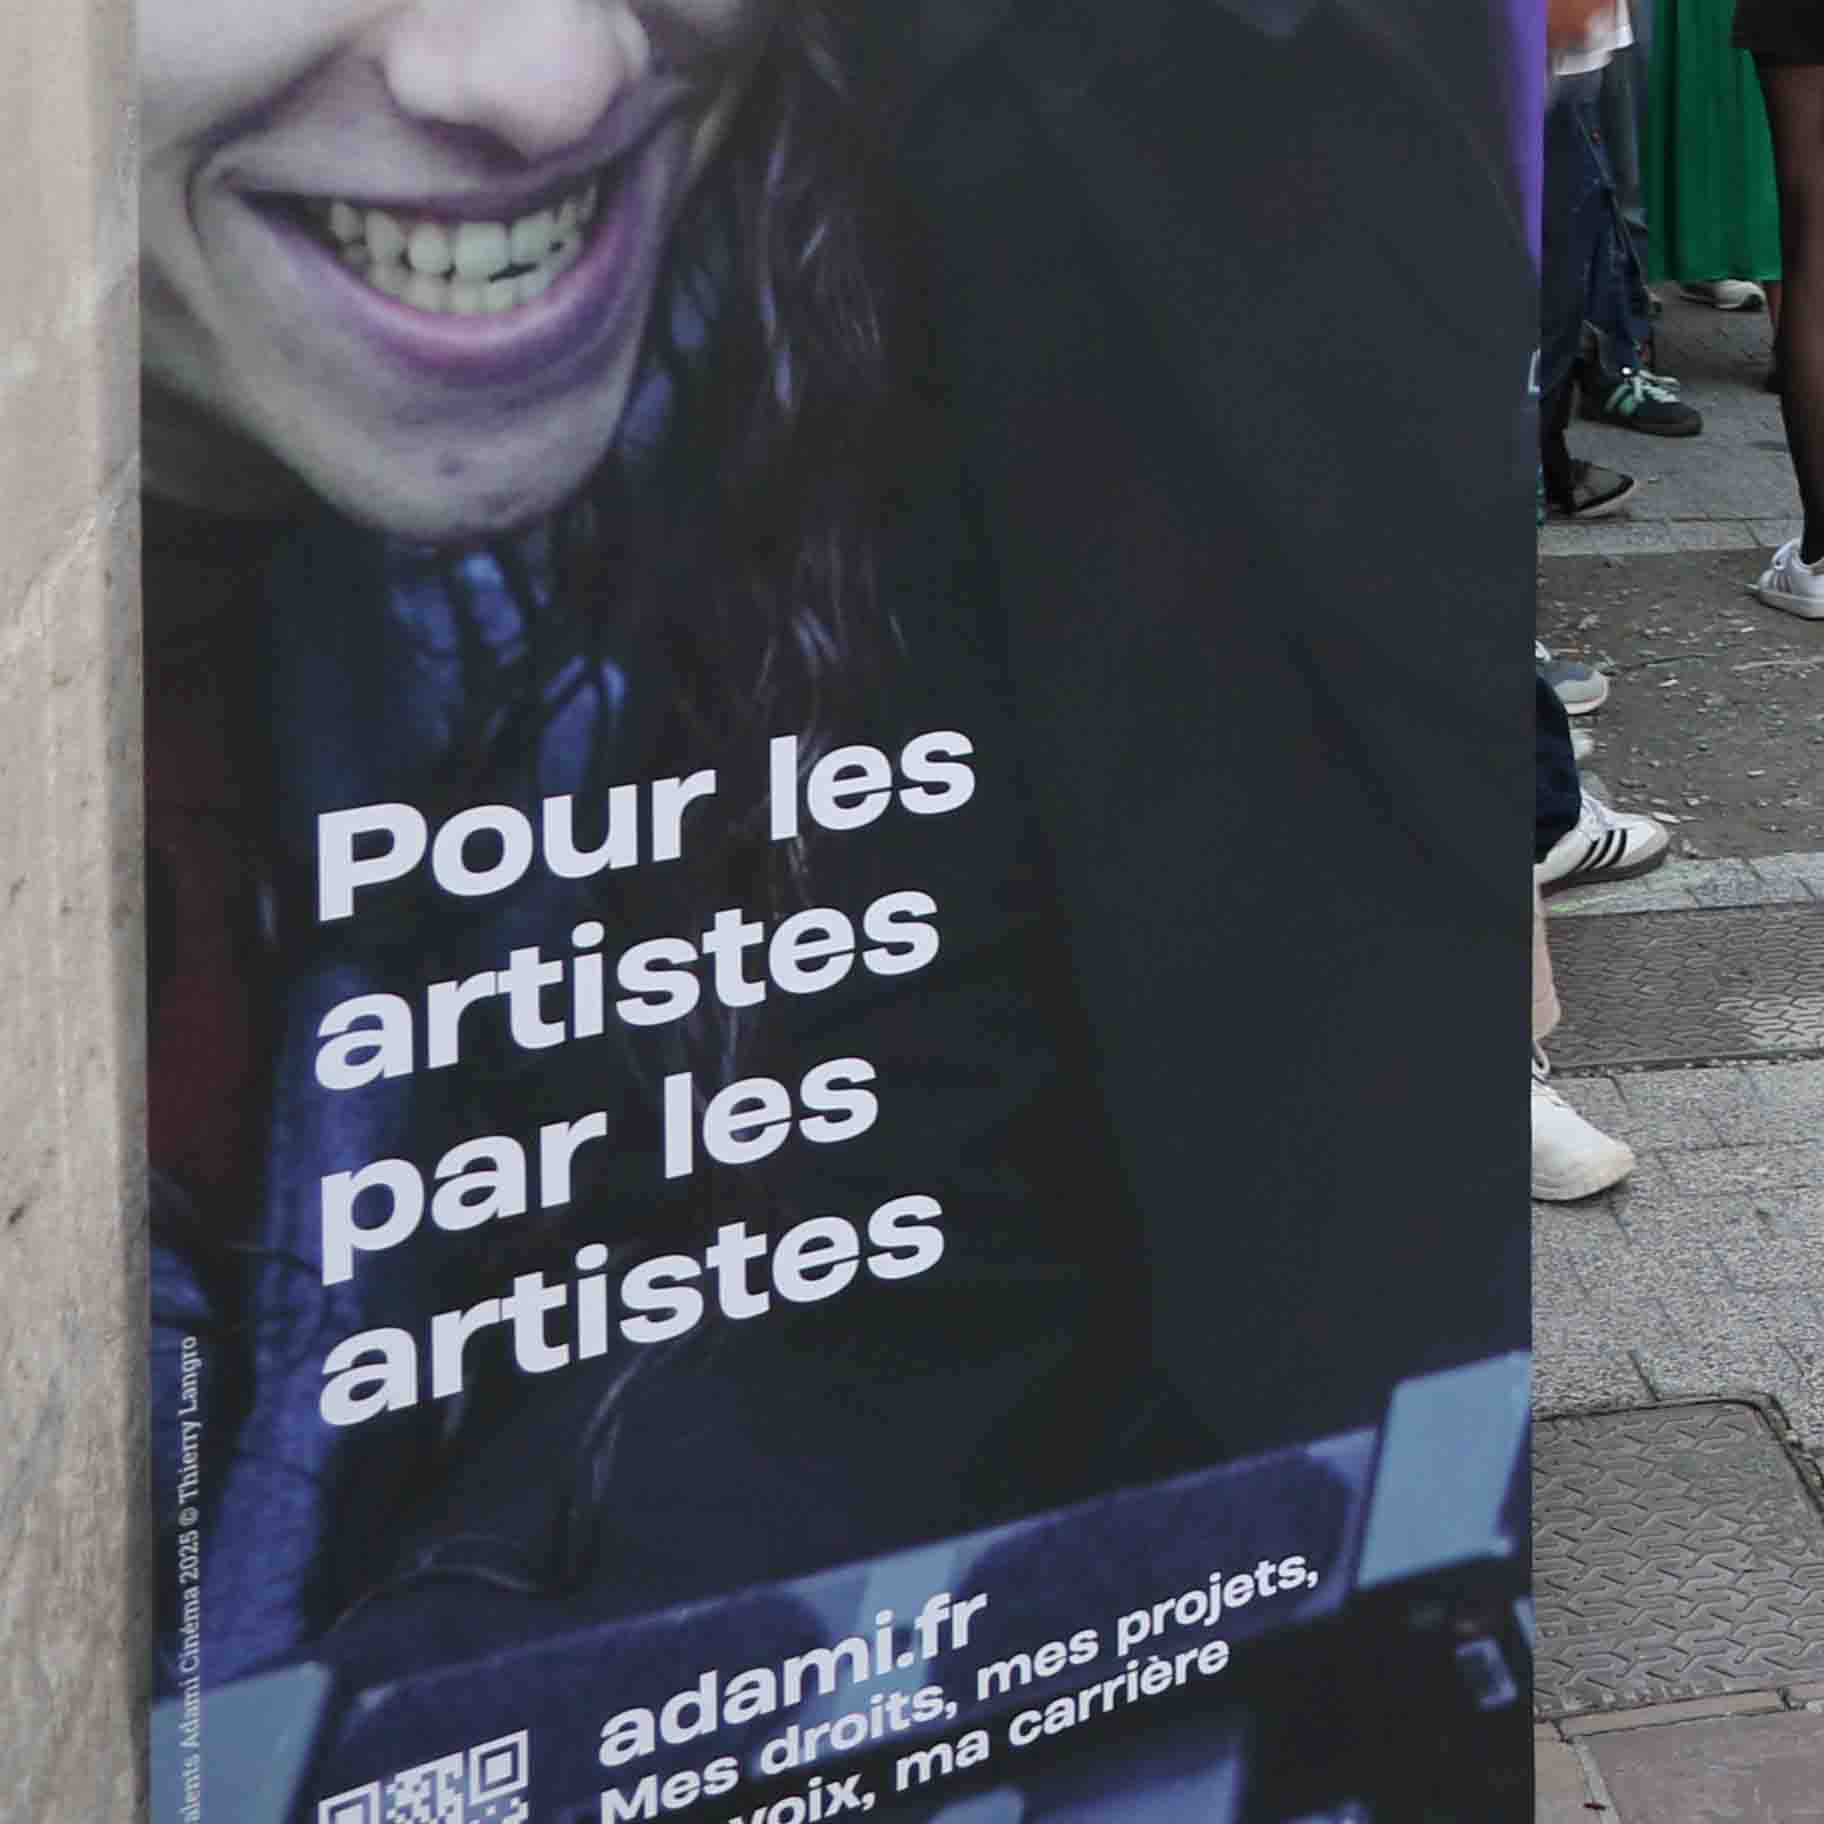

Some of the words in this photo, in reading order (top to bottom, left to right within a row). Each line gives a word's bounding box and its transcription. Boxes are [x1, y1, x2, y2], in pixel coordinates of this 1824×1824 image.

[318, 769, 716, 921] Pour
[770, 731, 975, 841] les
[315, 891, 939, 1090] artistes
[321, 1111, 607, 1286] par
[664, 1058, 878, 1179] les
[177, 1336, 203, 1416] Langro
[319, 1195, 944, 1426] artistes
[177, 1421, 202, 1505] Thierry
[178, 1530, 201, 1584] 2025
[179, 1585, 201, 1673] Cinéma
[177, 1675, 201, 1749] Adami
[599, 1592, 988, 1766] adami.fr
[600, 1757, 738, 1824] Mes
[760, 1684, 958, 1775] droits,
[977, 1629, 1100, 1700] mes
[1117, 1554, 1319, 1657] projets,
[896, 1729, 990, 1791] ma
[1008, 1639, 1230, 1746] carrière
